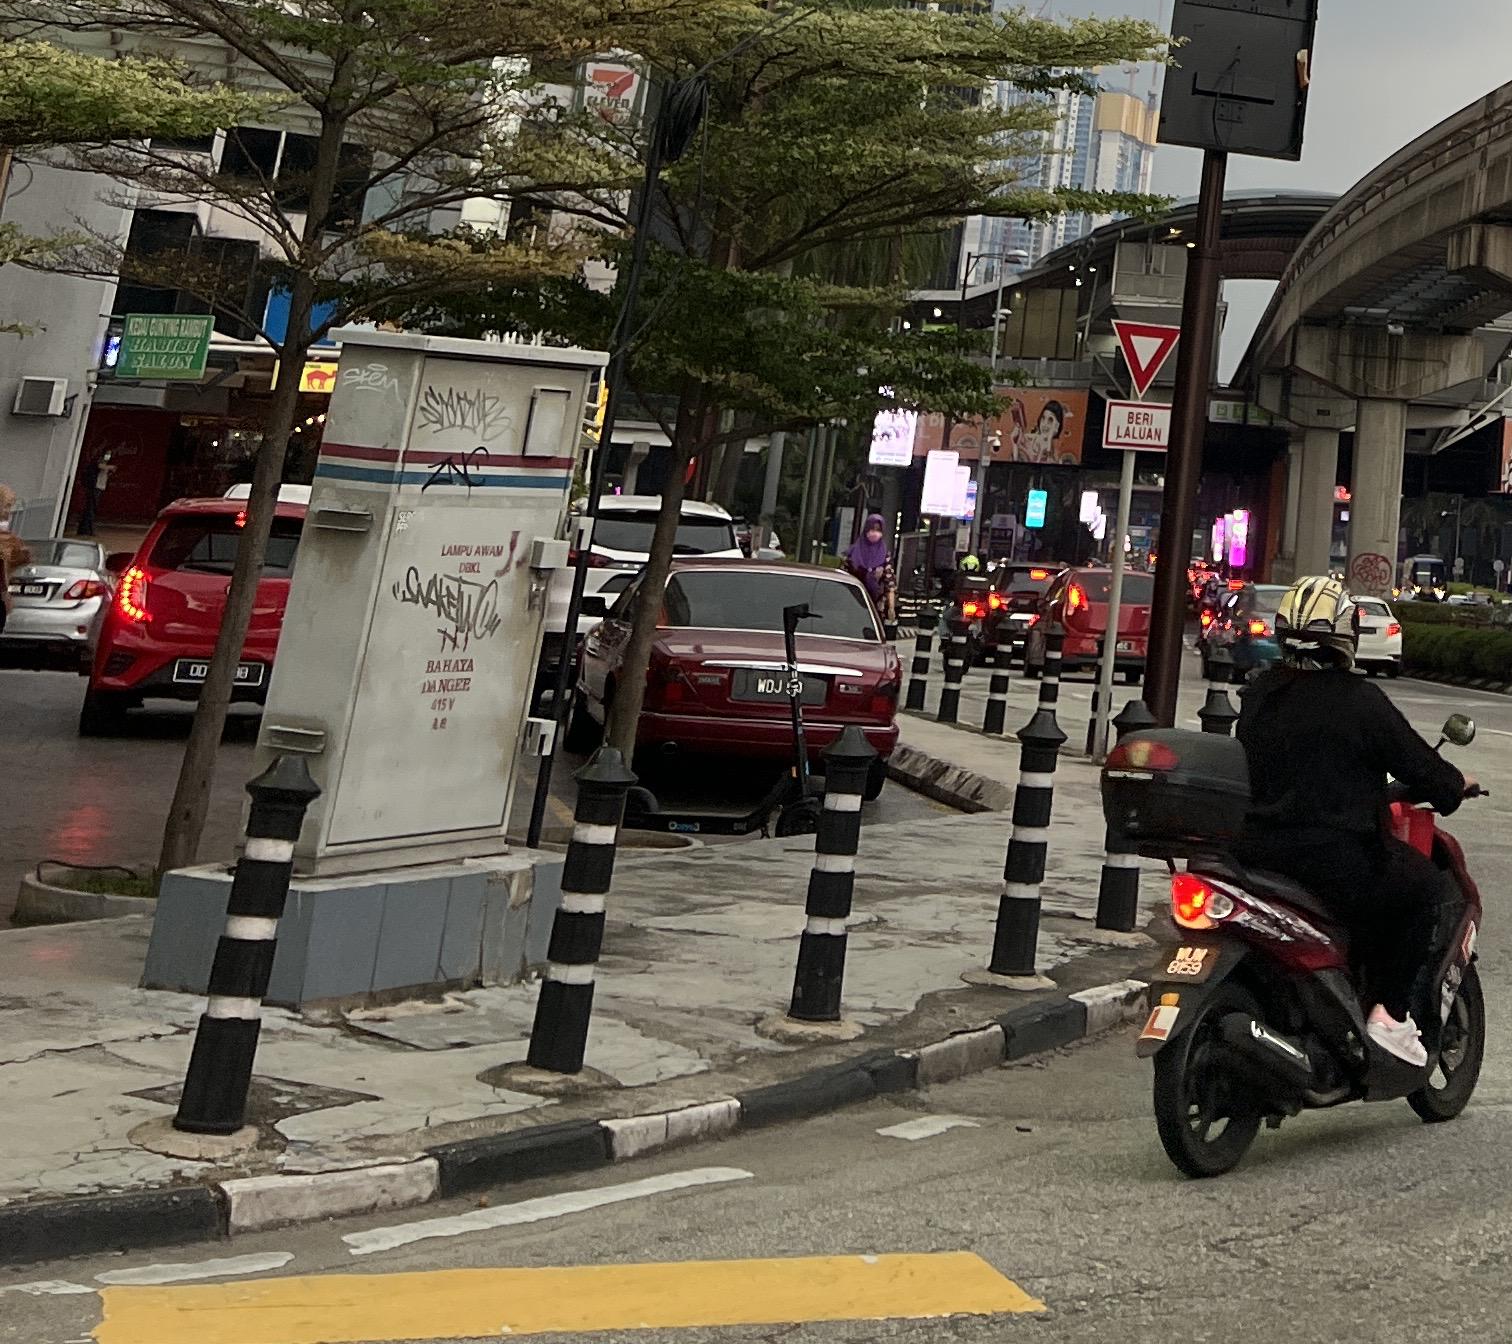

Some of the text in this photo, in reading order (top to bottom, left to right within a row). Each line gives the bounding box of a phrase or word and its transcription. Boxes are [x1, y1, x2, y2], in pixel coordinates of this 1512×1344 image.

[1127, 411, 1154, 426] BERI
[1115, 424, 1162, 442] LALUAN
[440, 544, 504, 557] LAMPU AWAM
[425, 658, 475, 673] BAHAYA
